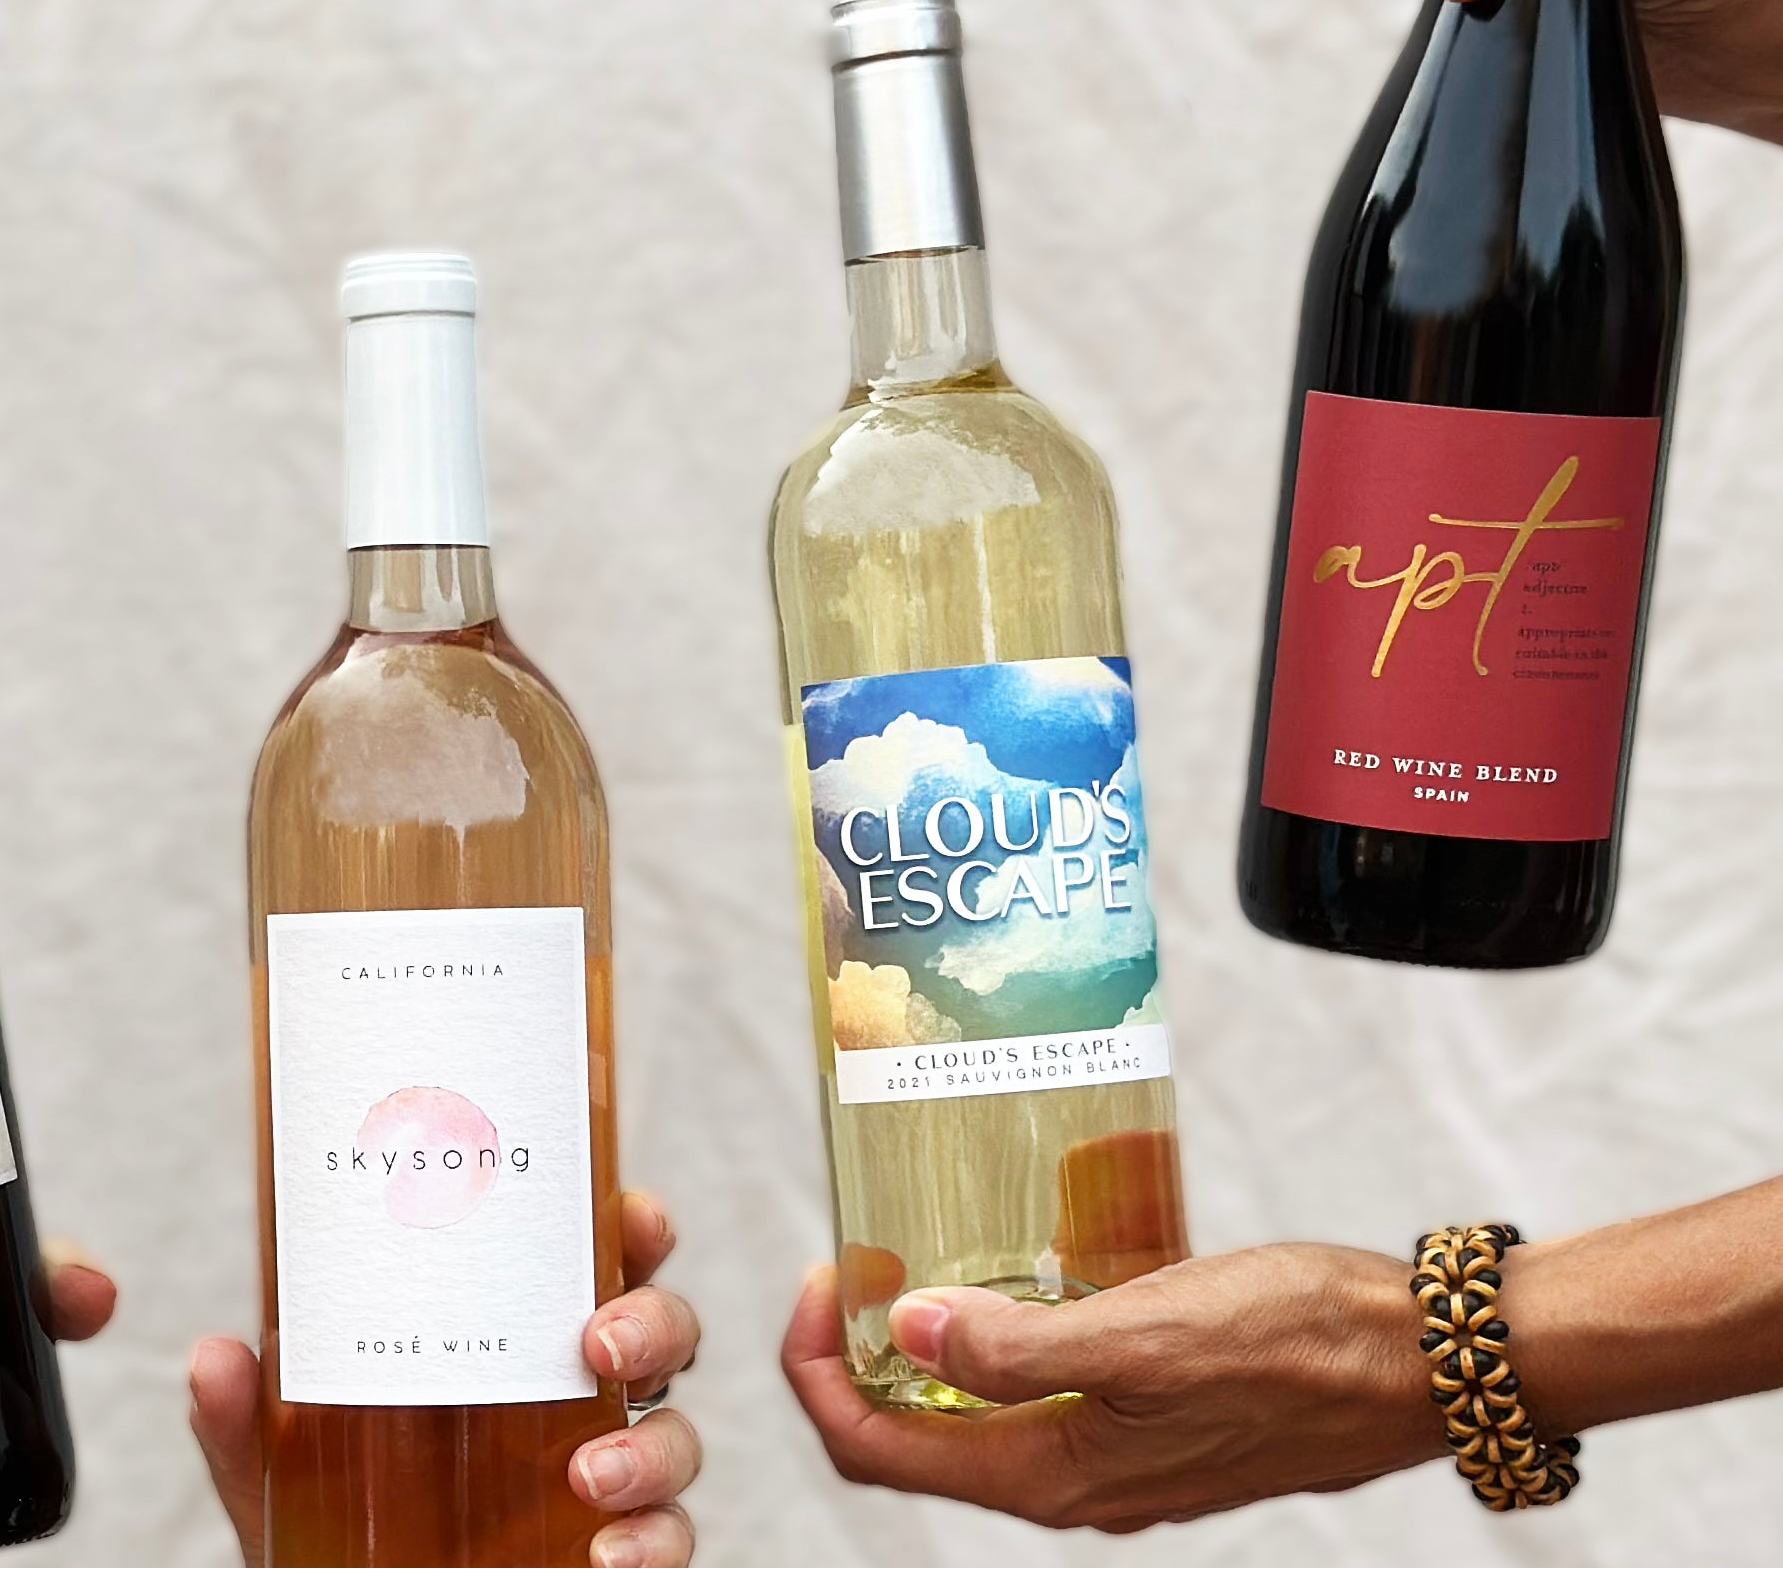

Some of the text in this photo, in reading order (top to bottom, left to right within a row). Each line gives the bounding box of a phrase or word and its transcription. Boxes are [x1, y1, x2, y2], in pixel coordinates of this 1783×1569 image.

[1313, 455, 1625, 678] apt
[1334, 749, 1559, 784] RED WINE BLEND
[1413, 786, 1470, 803] SPAIN
[840, 780, 1131, 867] CLOUD'S
[859, 849, 1133, 930] ESCAPE
[341, 964, 505, 981] CALIFORNIA
[915, 1037, 1117, 1071] CLOUD'S ESCAPE
[887, 1056, 1141, 1090] 2021 SAUVIGNON BLANC
[327, 1143, 531, 1176] skysong
[357, 1335, 509, 1355] ROSÉ WINE
